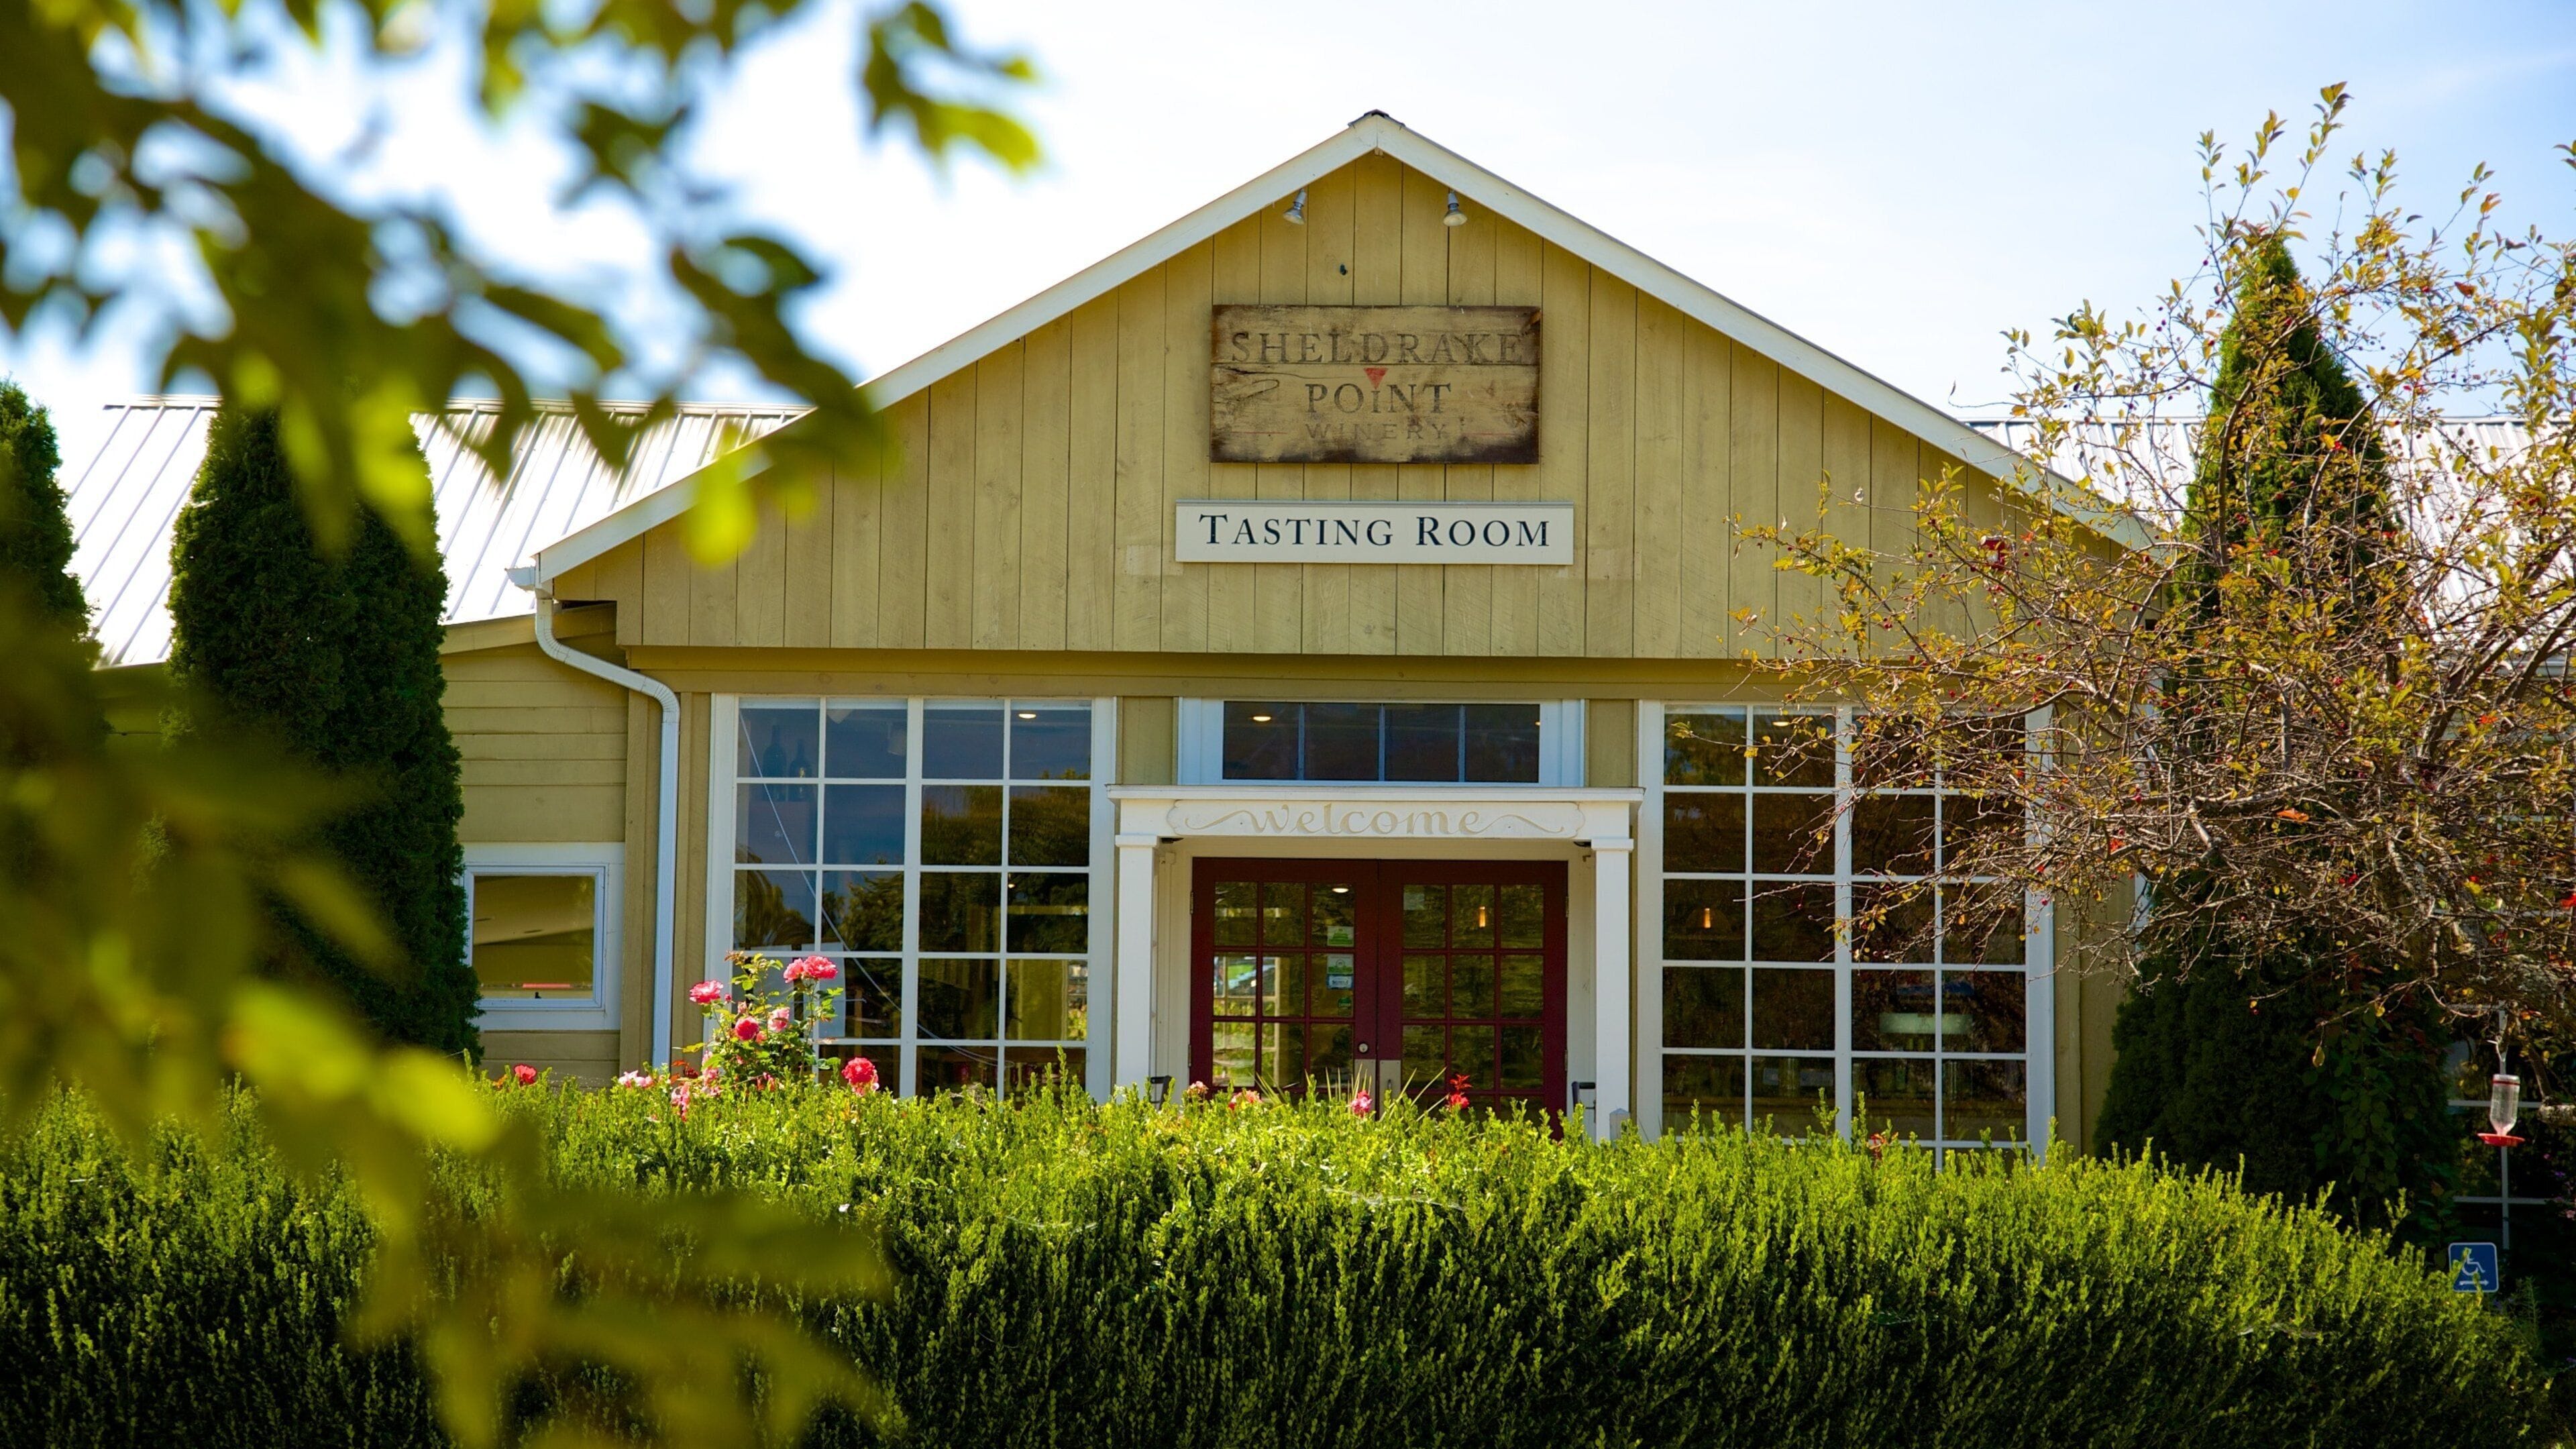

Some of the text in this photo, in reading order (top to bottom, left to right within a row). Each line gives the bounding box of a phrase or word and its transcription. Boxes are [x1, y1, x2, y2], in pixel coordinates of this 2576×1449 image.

[1230, 331, 1524, 365] SHELDRAKE
[1305, 383, 1452, 413] POINT
[1305, 423, 1446, 440] WINERY
[1199, 513, 1550, 547] TASTING ROOM
[1246, 803, 1487, 835] welcome
